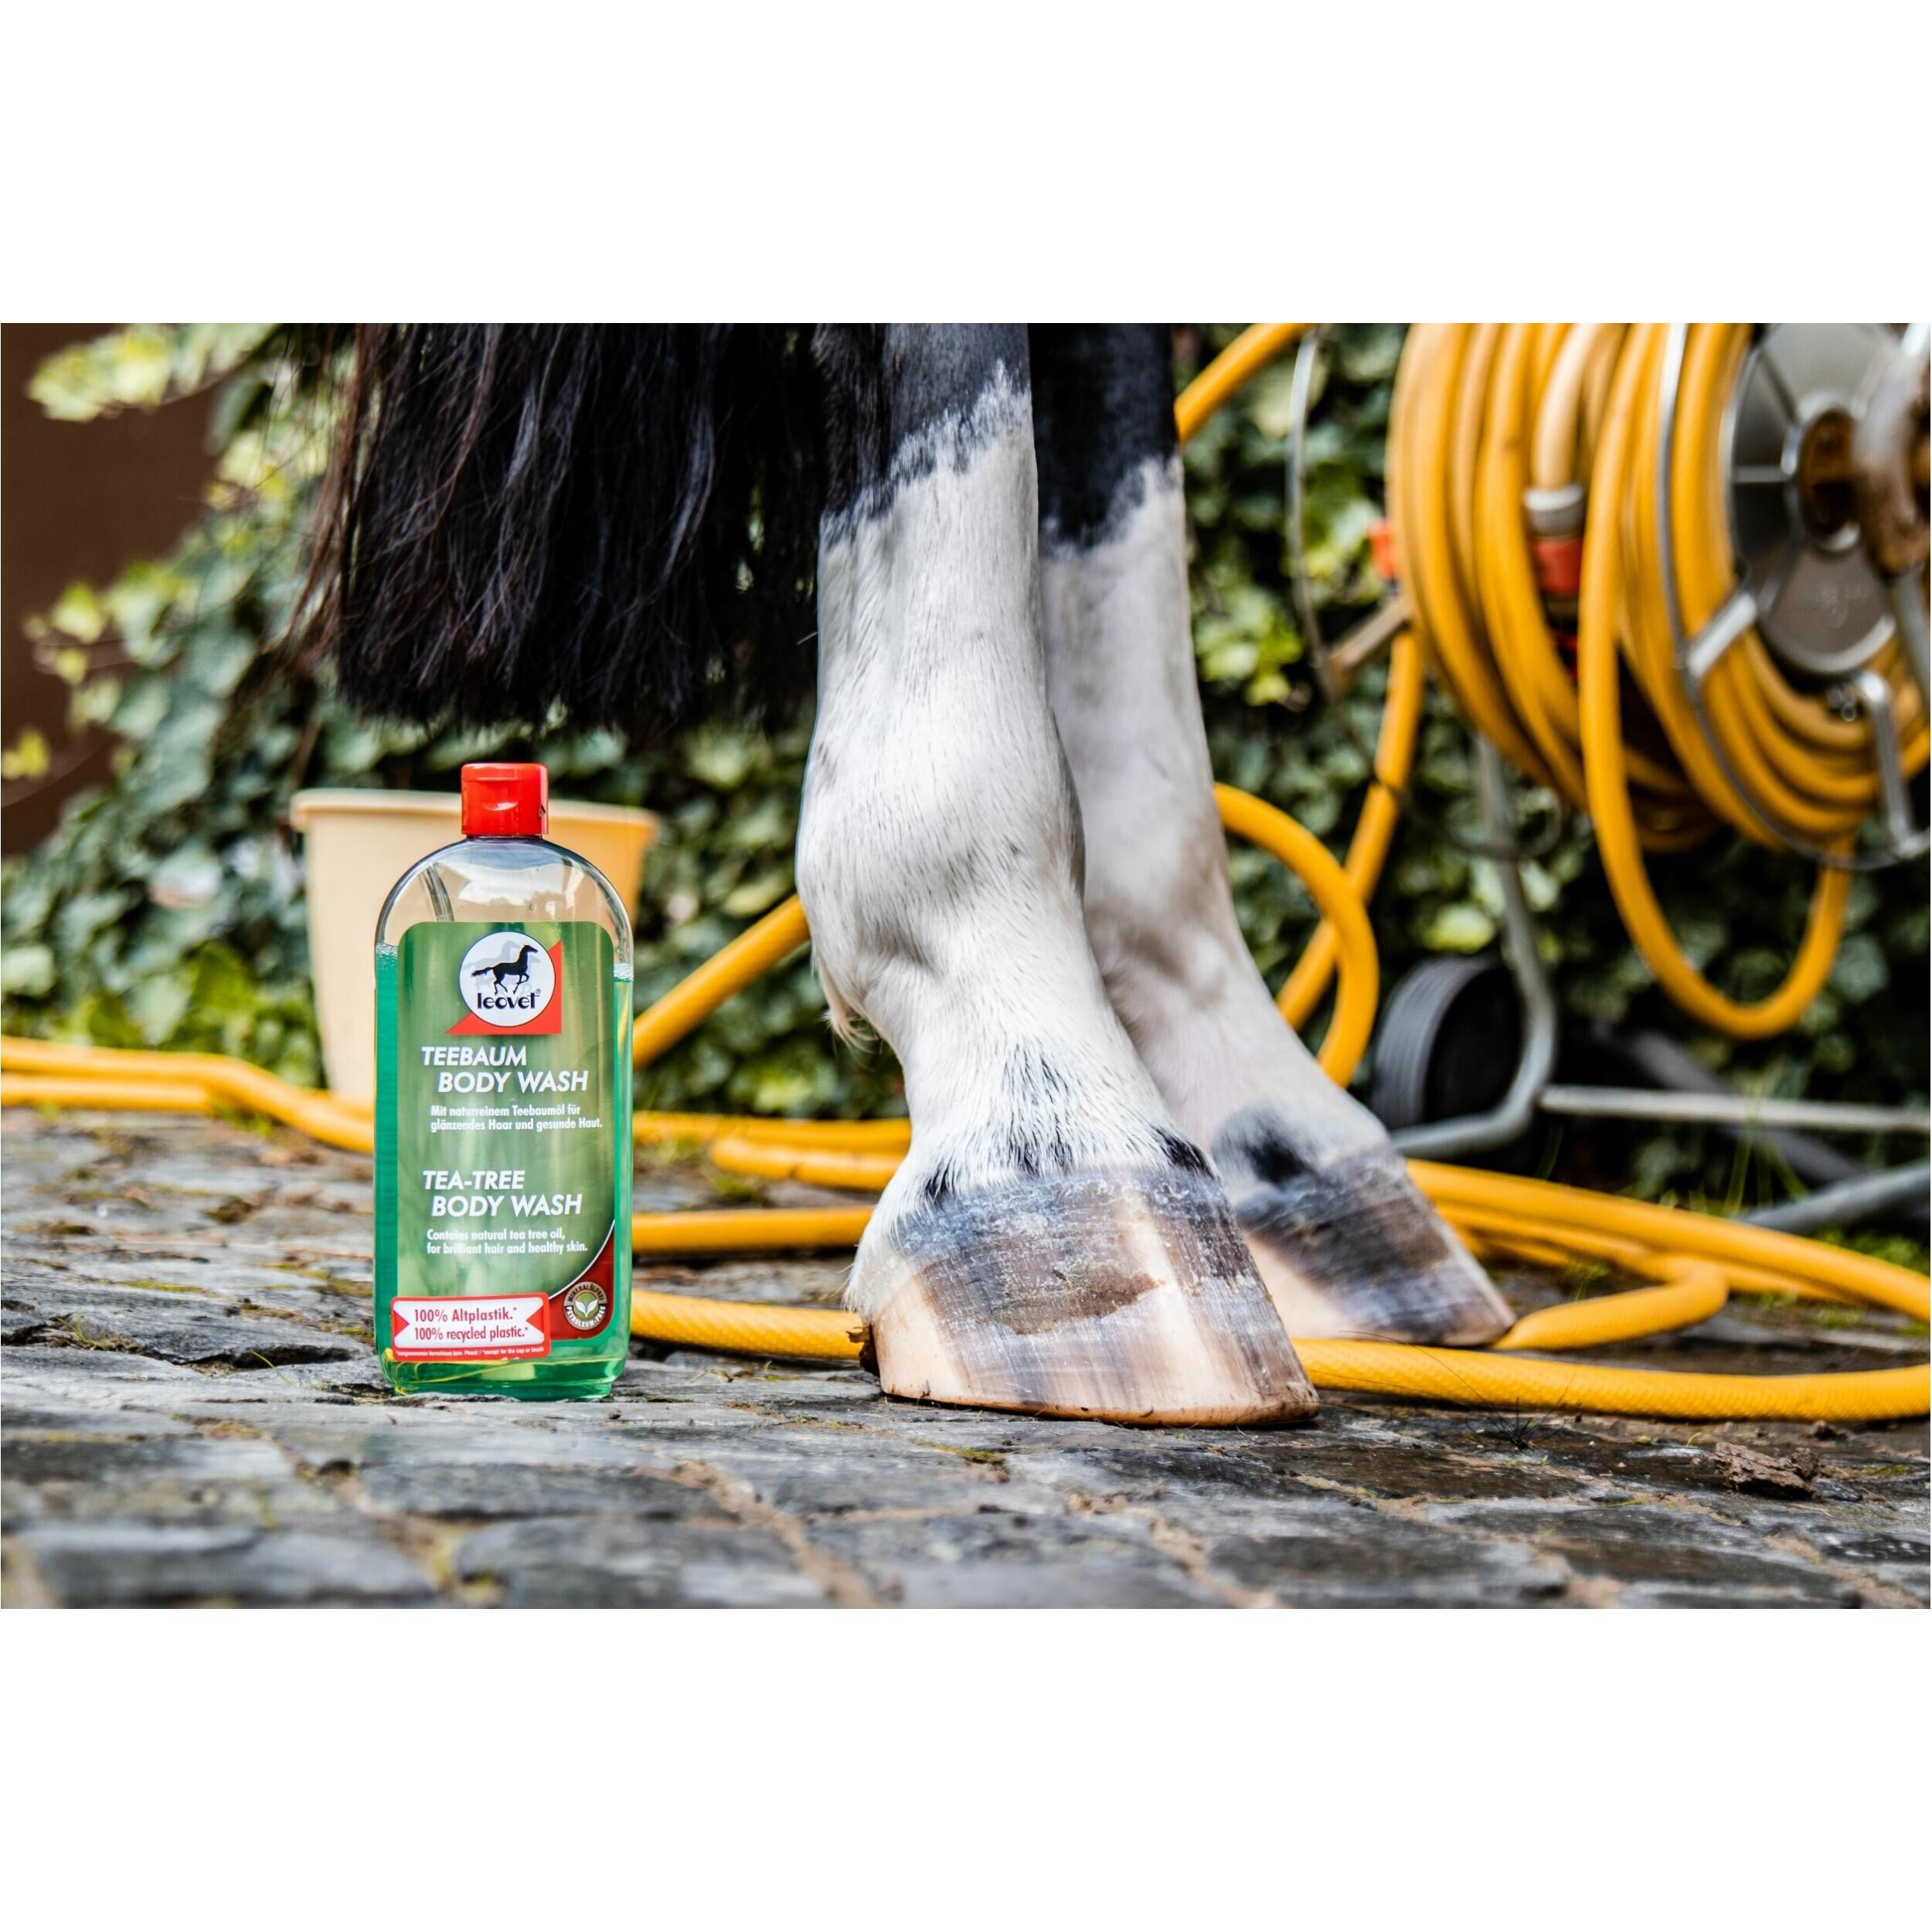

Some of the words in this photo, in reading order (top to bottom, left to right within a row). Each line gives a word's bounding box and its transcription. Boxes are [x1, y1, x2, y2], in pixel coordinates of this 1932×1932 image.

[421, 1046, 527, 1066] TEEBAUM
[438, 1071, 512, 1093] BODY
[517, 1070, 589, 1094] WASH
[430, 1105, 447, 1117] Mit
[450, 1106, 509, 1117] naturreinem
[512, 1104, 565, 1117] Teebaumöl
[567, 1104, 581, 1115] für
[430, 1119, 485, 1133] glänzendes
[488, 1119, 512, 1131] Haar
[515, 1118, 534, 1130] und
[536, 1117, 577, 1132] gesunde
[579, 1117, 603, 1128] Haut.
[423, 1170, 526, 1190] TEA-TREE
[432, 1195, 505, 1217] BODY
[511, 1193, 583, 1217] WASH
[427, 1229, 468, 1240] Contains
[471, 1228, 507, 1240] natural
[509, 1230, 526, 1240] tea
[528, 1229, 548, 1240] tree
[549, 1227, 566, 1241] oil,
[427, 1242, 440, 1254] for
[443, 1242, 482, 1254] brilliant
[485, 1242, 505, 1254] hair
[507, 1242, 526, 1253] and
[528, 1241, 564, 1255] healthy
[566, 1240, 588, 1252] skin.
[414, 1309, 448, 1322] 100%
[414, 1327, 444, 1340] 100%
[447, 1326, 486, 1343] recycled
